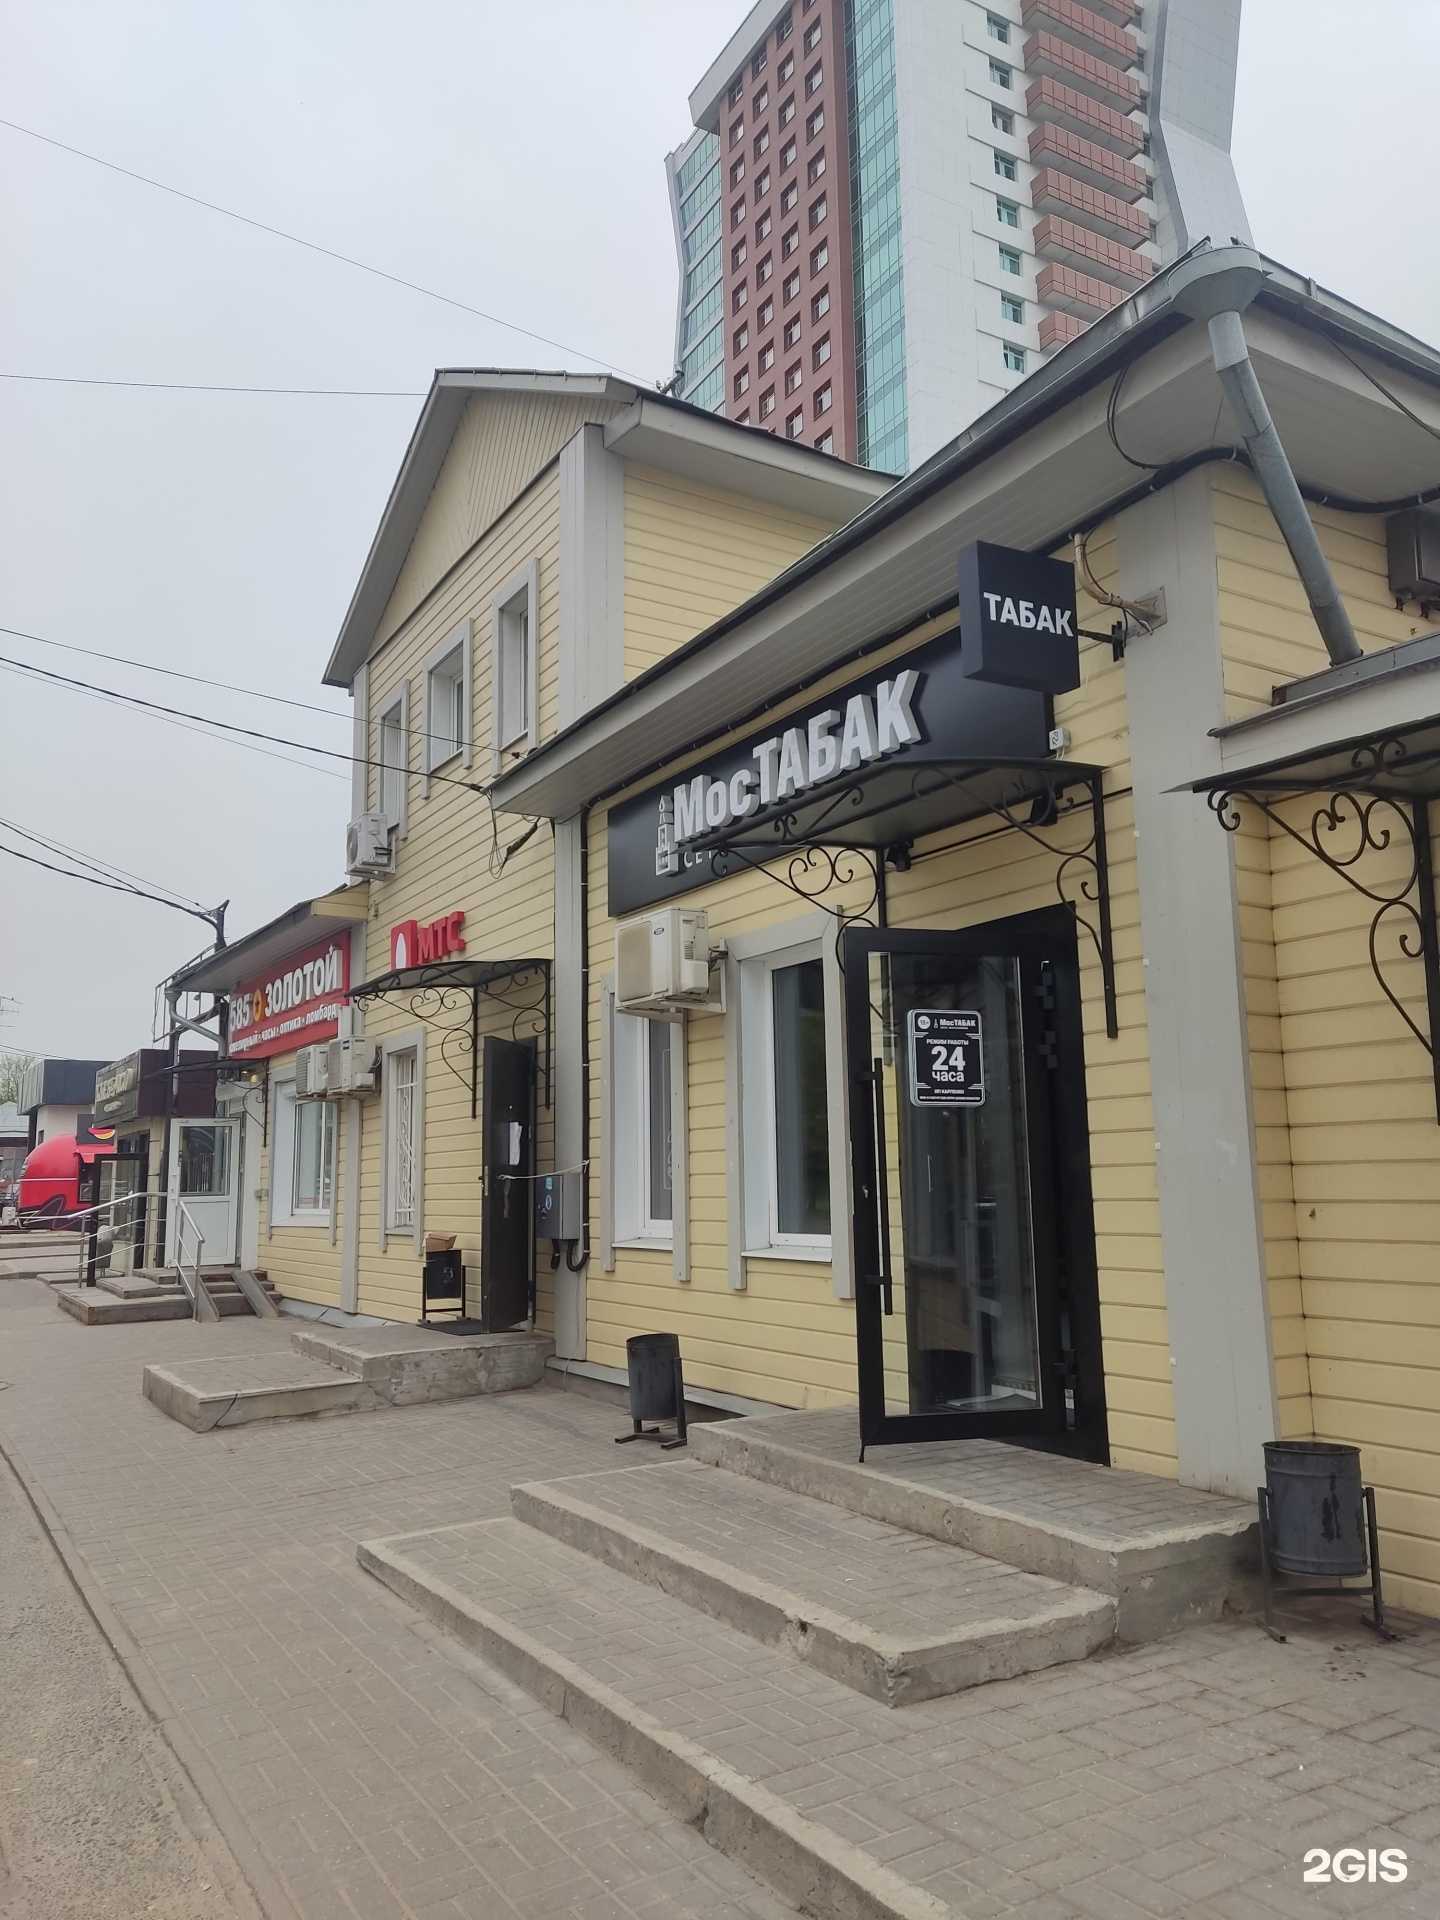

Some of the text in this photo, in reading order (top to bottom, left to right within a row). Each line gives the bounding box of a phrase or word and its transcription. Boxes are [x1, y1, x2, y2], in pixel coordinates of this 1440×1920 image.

[983, 591, 1074, 637] ТАБАК
[673, 669, 922, 844] МосТАБАК
[417, 910, 465, 965] МТС
[228, 944, 343, 1032] 585 ЗОЛОТОЙ
[305, 1002, 338, 1024] ломбард
[931, 1045, 966, 1071] 24
[931, 1071, 965, 1082] часа
